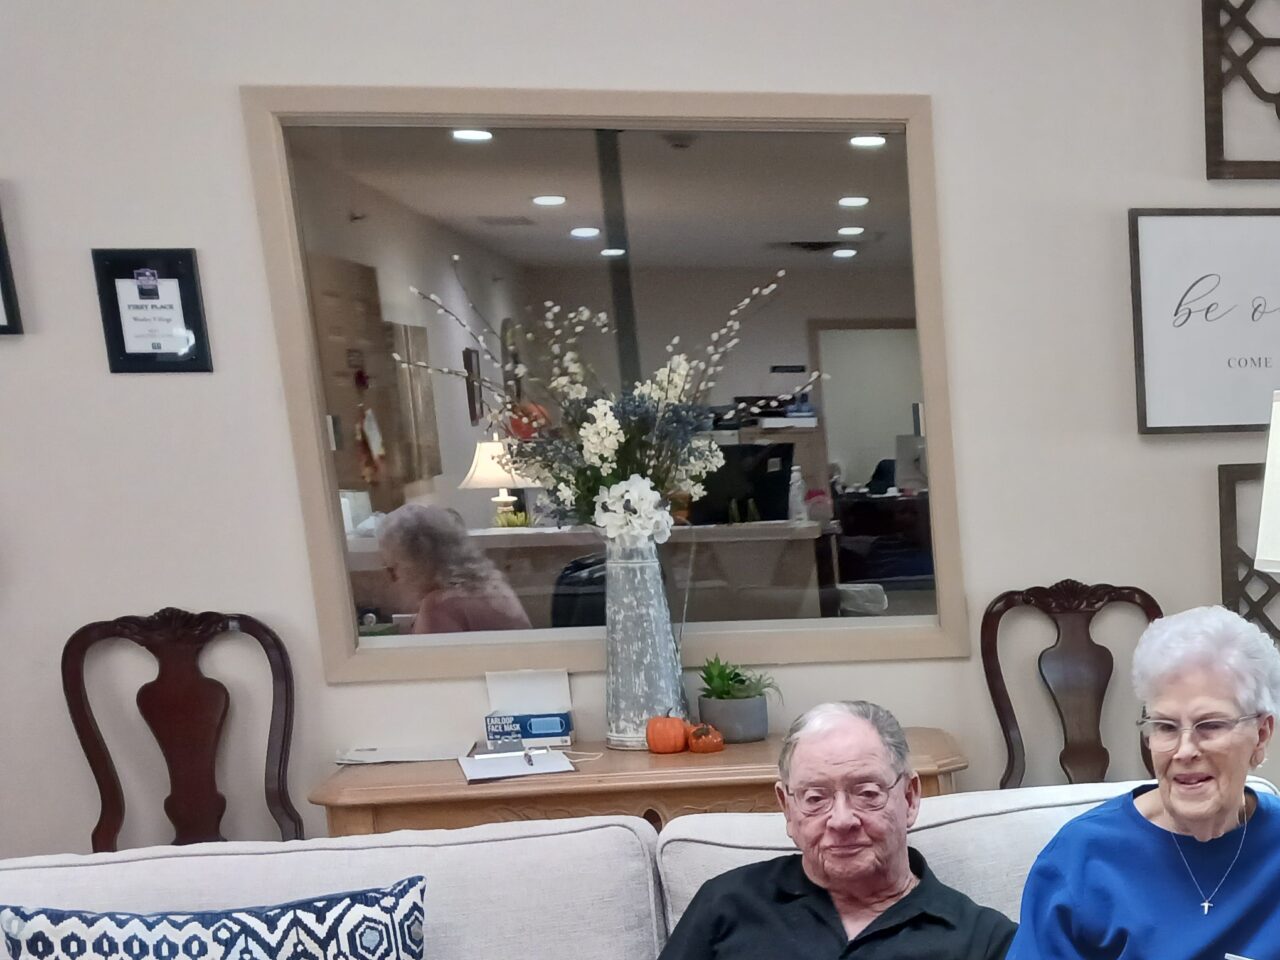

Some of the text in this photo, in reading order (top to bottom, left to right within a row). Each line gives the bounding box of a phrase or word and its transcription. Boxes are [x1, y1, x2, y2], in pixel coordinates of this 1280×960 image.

[1172, 273, 1237, 328] be
[1227, 356, 1273, 369] COME
[487, 717, 514, 725] EARLOOP
[488, 723, 521, 732] FACE MASK
